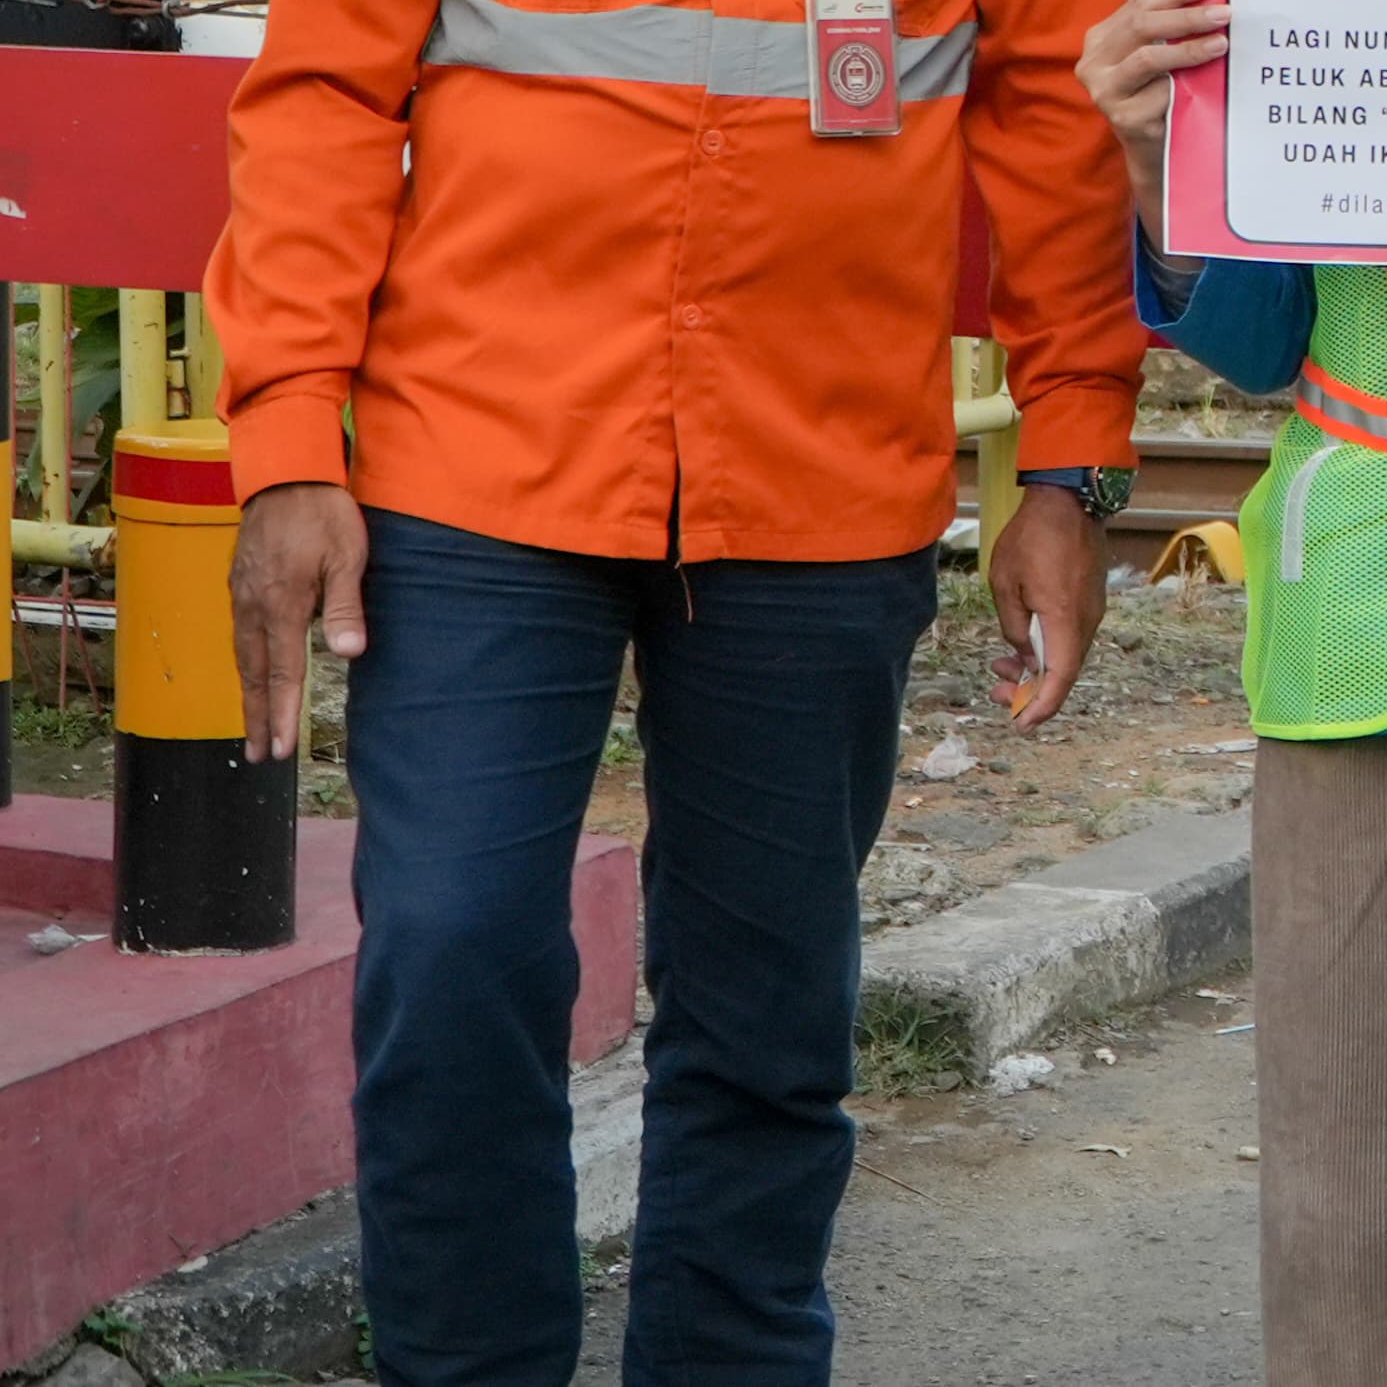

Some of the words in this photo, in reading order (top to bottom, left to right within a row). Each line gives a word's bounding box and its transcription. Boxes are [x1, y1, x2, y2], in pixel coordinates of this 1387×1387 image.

[1270, 29, 1332, 49] LAGI
[1261, 67, 1345, 87] PELUK
[1269, 105, 1368, 126] BILANG
[1283, 143, 1357, 164] UDAH
